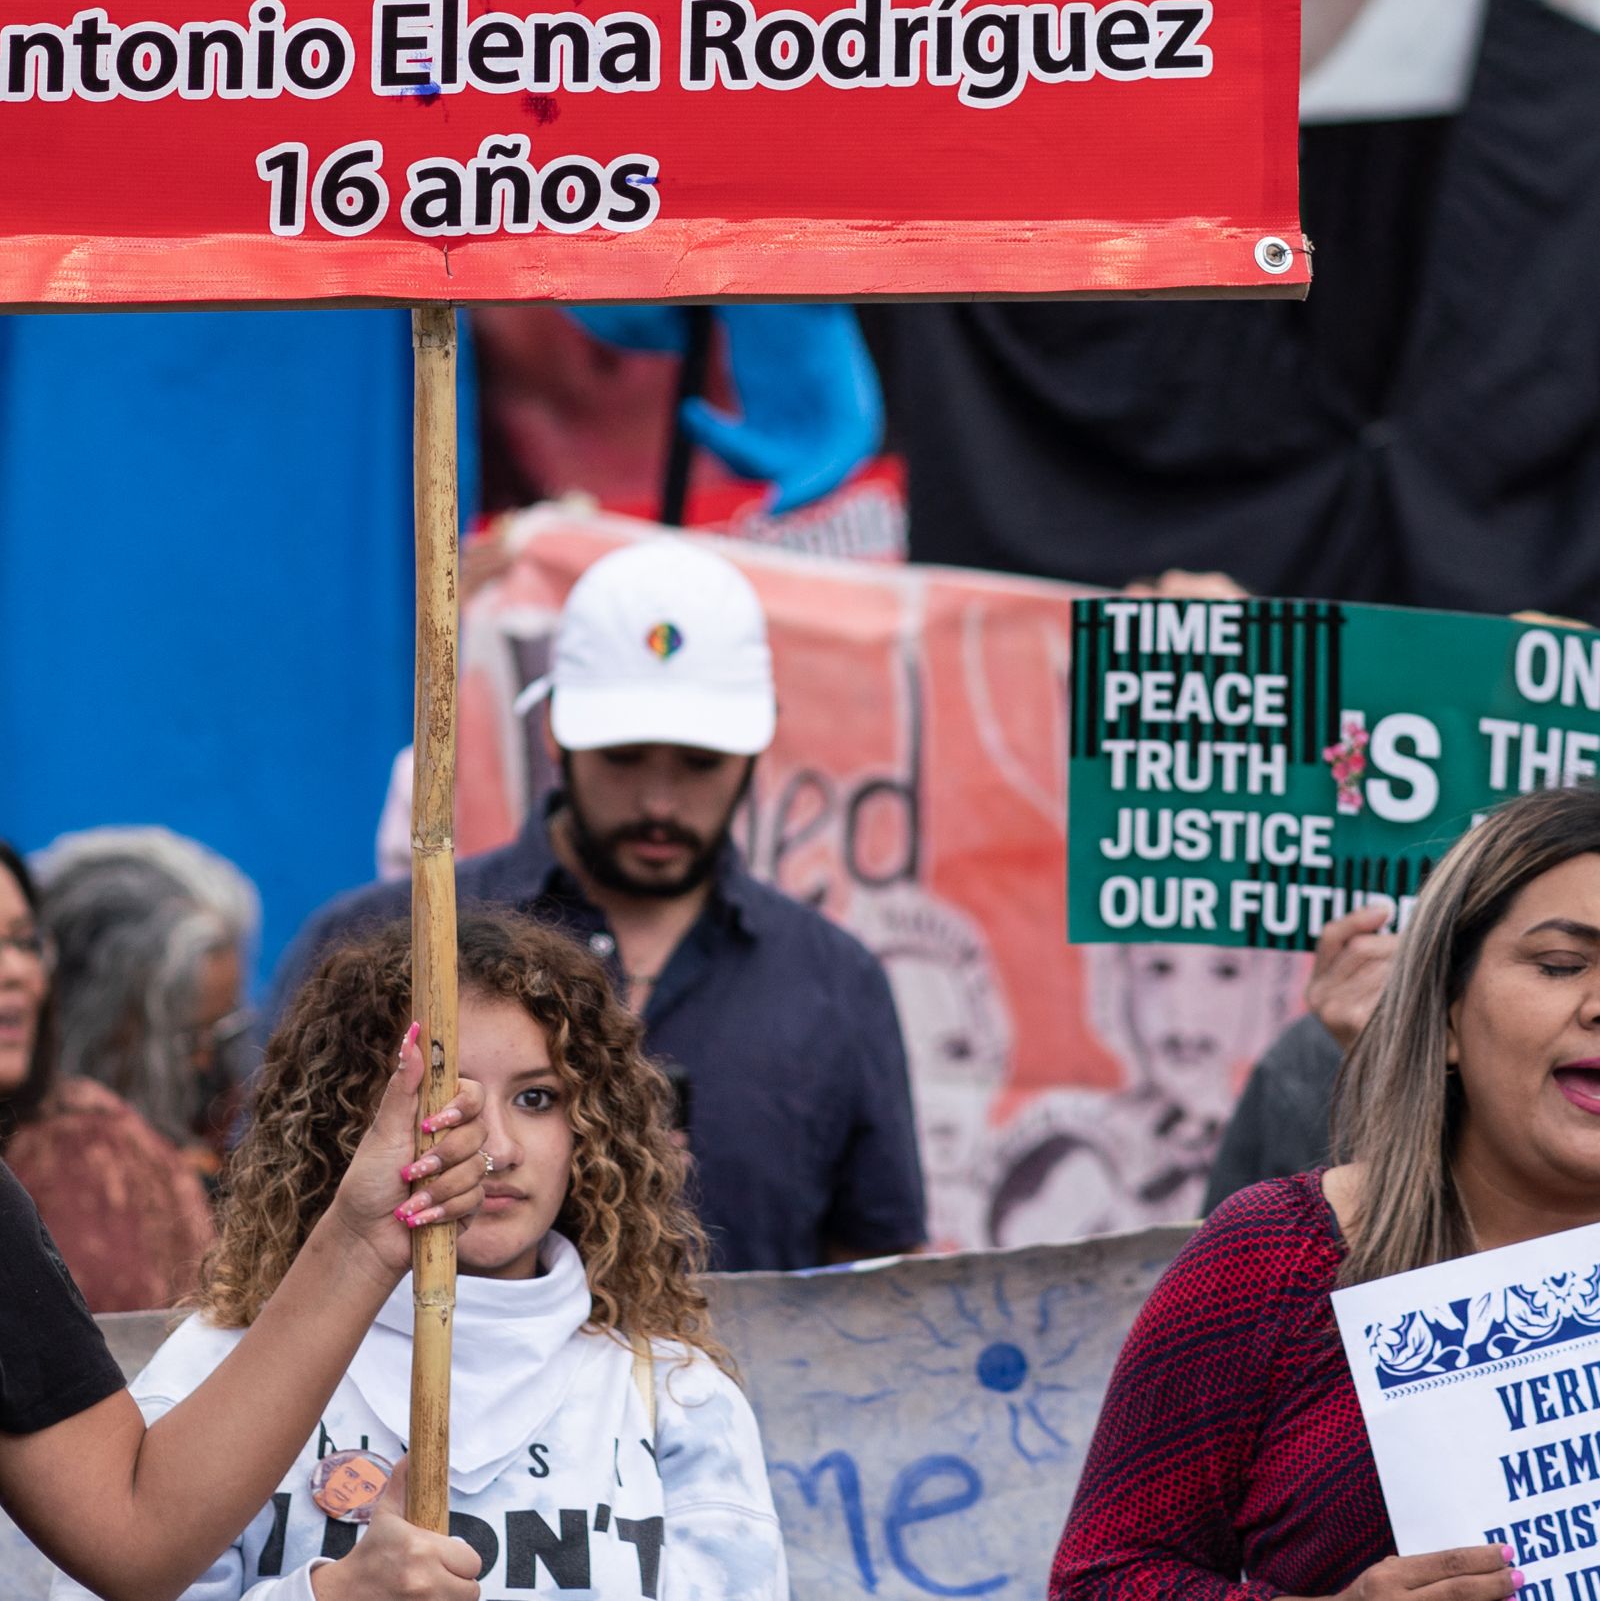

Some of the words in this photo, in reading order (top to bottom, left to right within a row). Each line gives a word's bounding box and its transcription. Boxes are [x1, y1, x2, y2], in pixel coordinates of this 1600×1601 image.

[258, 141, 385, 235] 16
[406, 133, 659, 235] años
[1105, 603, 1243, 655] TIME
[1103, 672, 1287, 727] PEACE
[1103, 740, 1286, 794] TRUTH
[1324, 709, 1442, 823] IS
[1479, 717, 1600, 792] THE
[1101, 809, 1333, 868] JUSTICE
[1100, 876, 1217, 929] OUR
